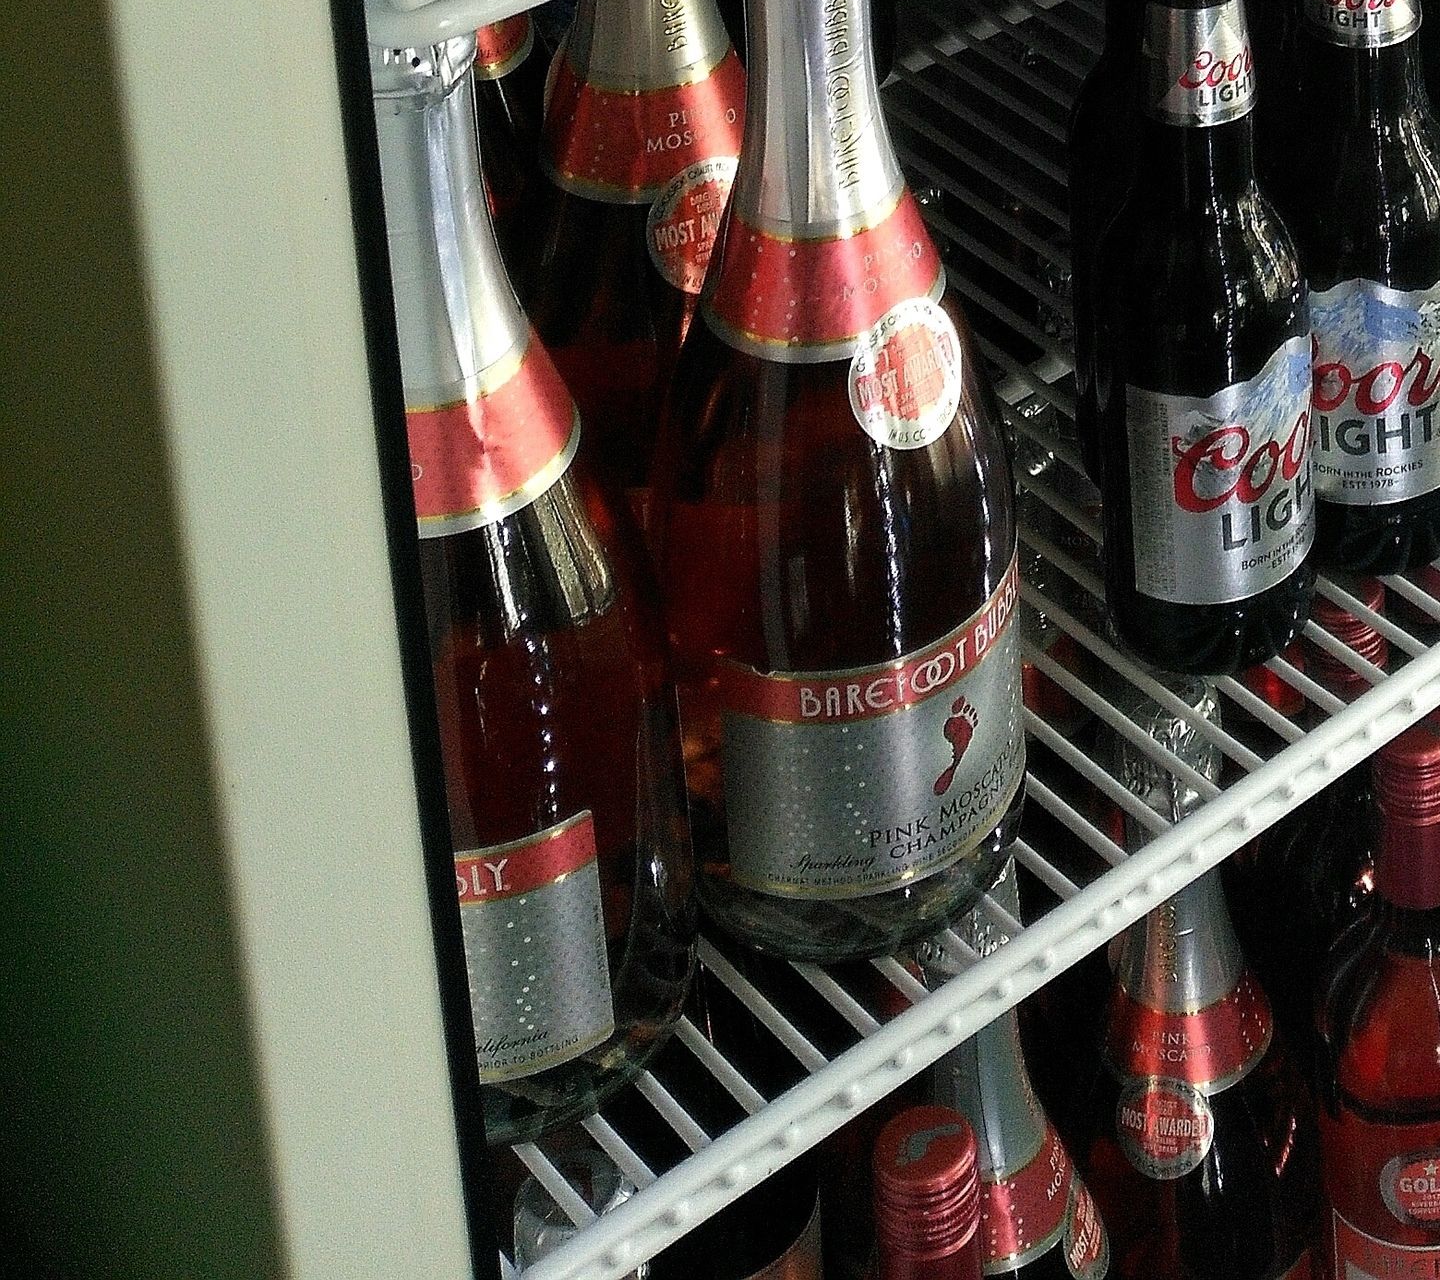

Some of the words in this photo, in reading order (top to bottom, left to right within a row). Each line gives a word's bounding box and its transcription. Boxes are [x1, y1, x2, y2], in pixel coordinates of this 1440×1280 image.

[1178, 45, 1252, 90] Coor
[655, 218, 697, 251] MOST
[857, 369, 899, 411] MOST
[1317, 401, 1440, 456] IGHT
[1354, 469, 1373, 479] THE
[1376, 459, 1424, 478] ROCKIES
[1221, 476, 1314, 552] LIGH
[1241, 551, 1271, 571] BORN
[800, 636, 968, 718] BAREFOOT
[973, 563, 1019, 656] BUBBL
[869, 815, 930, 848] PINK
[939, 742, 1011, 823] MOSCATO
[889, 775, 1005, 859] CHAMPAGNE
[476, 1030, 549, 1059] alifornia
[1121, 1106, 1150, 1130] MOST
